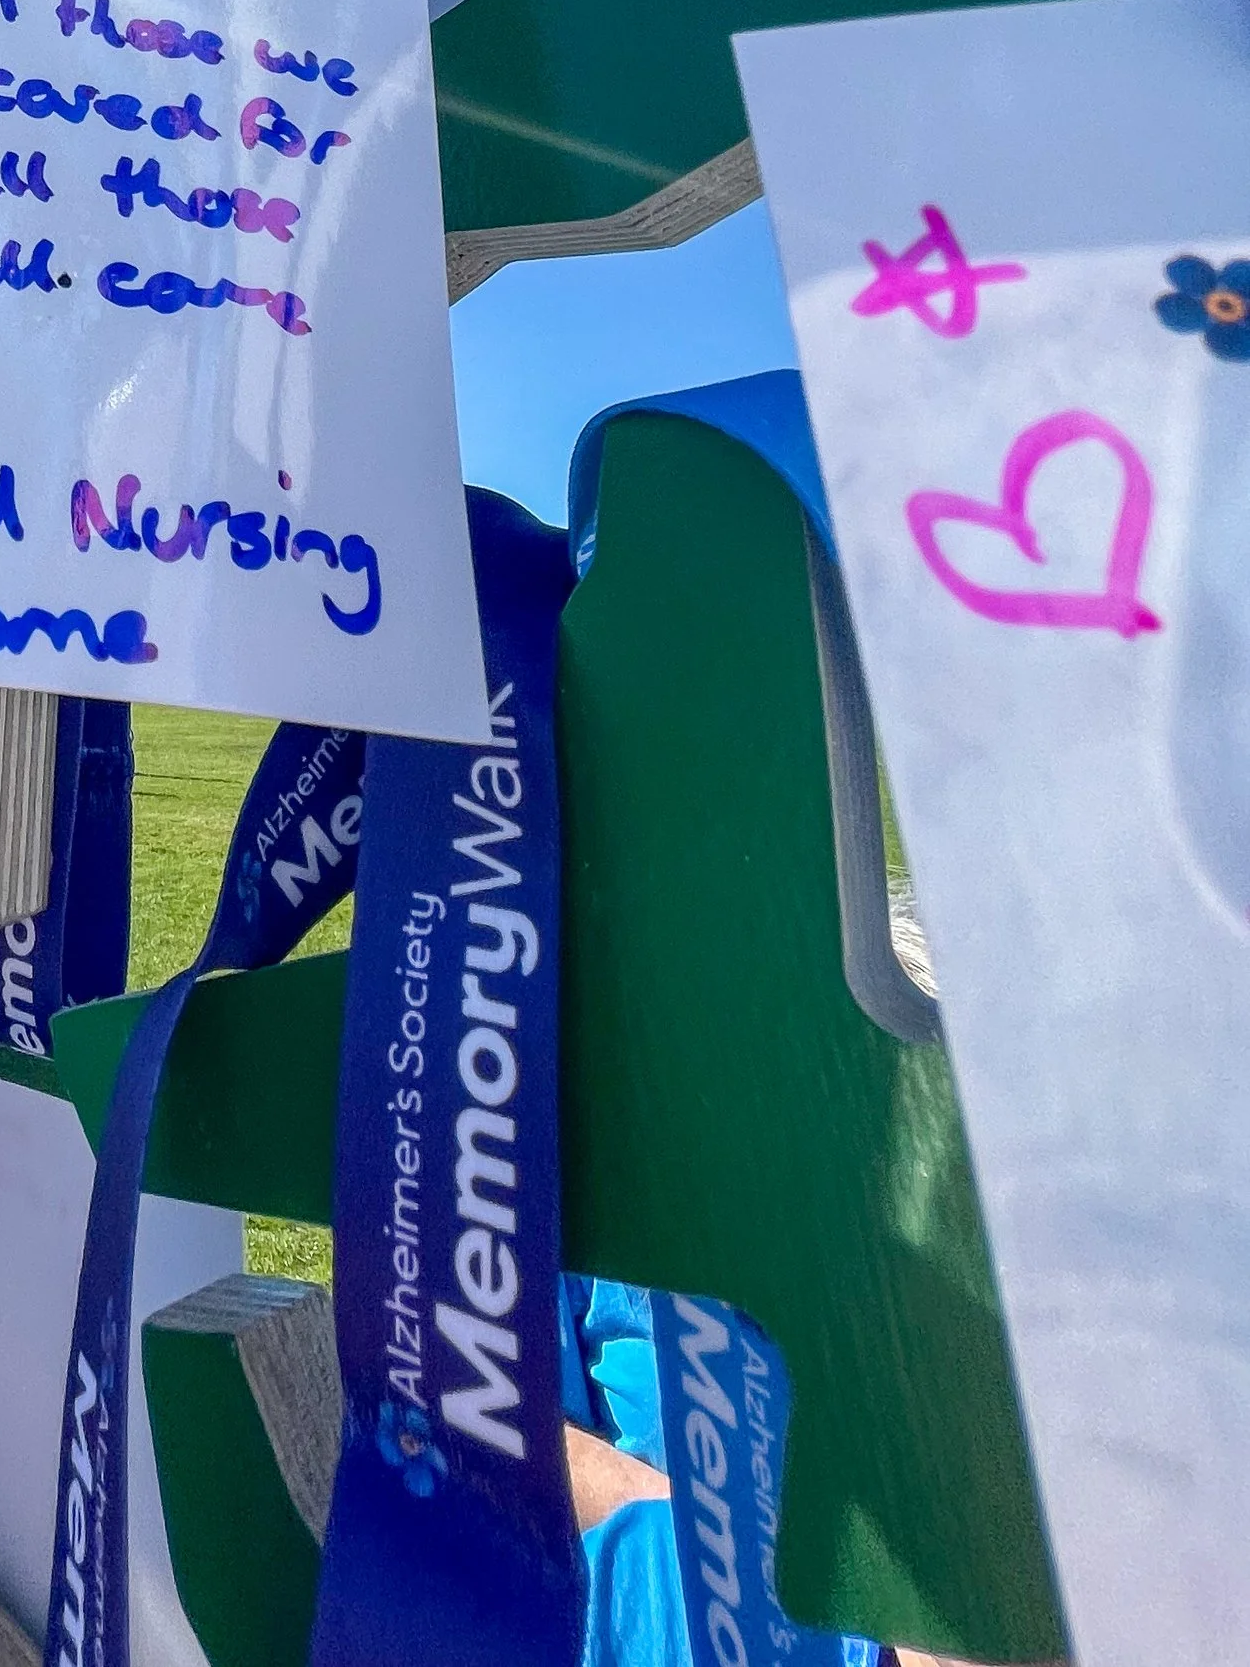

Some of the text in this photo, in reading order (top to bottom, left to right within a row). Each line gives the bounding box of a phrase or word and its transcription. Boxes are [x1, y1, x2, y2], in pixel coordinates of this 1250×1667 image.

[254, 39, 359, 96] we
[239, 96, 351, 165] for
[100, 156, 302, 244] those
[70, 470, 383, 635] Nursing
[385, 891, 446, 1410] Alzheimer's Society
